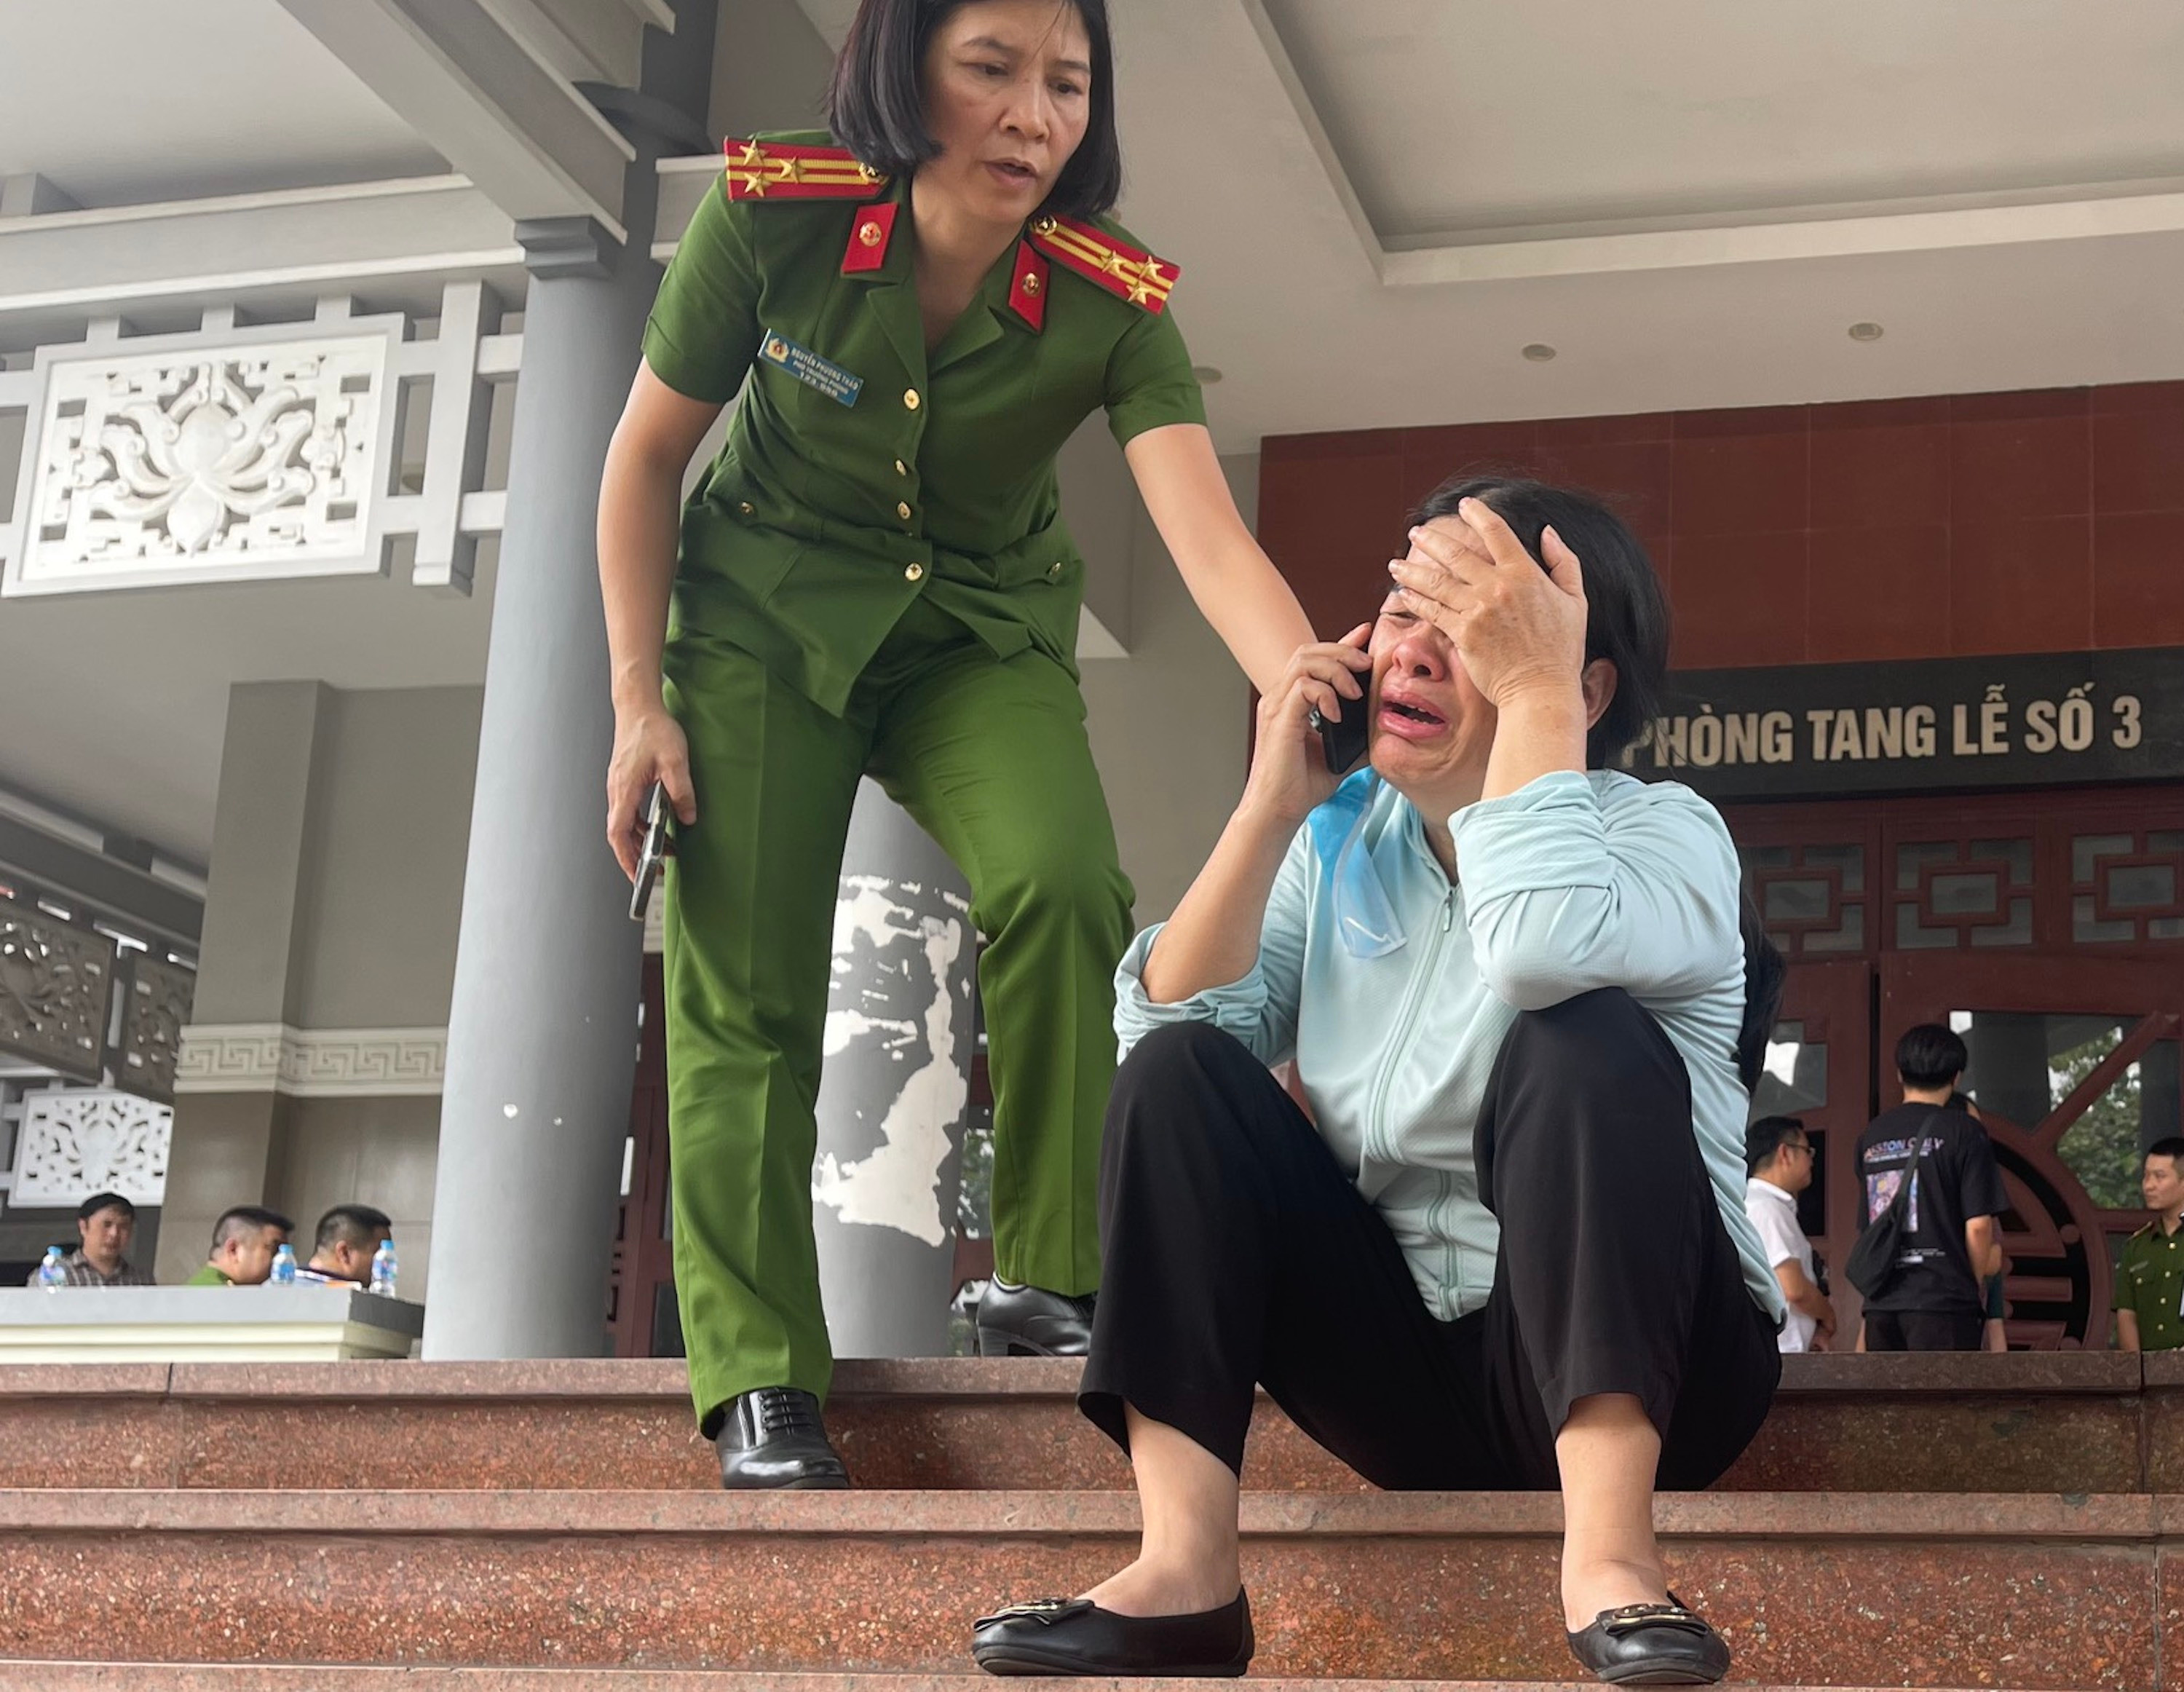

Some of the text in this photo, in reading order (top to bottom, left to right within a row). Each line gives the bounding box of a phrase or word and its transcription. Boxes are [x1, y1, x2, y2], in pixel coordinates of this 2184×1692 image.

[1807, 705, 1936, 761] TANG
[1953, 683, 2009, 755] LỄ
[2025, 682, 2095, 753] SỐ
[2113, 695, 2142, 748] 3
